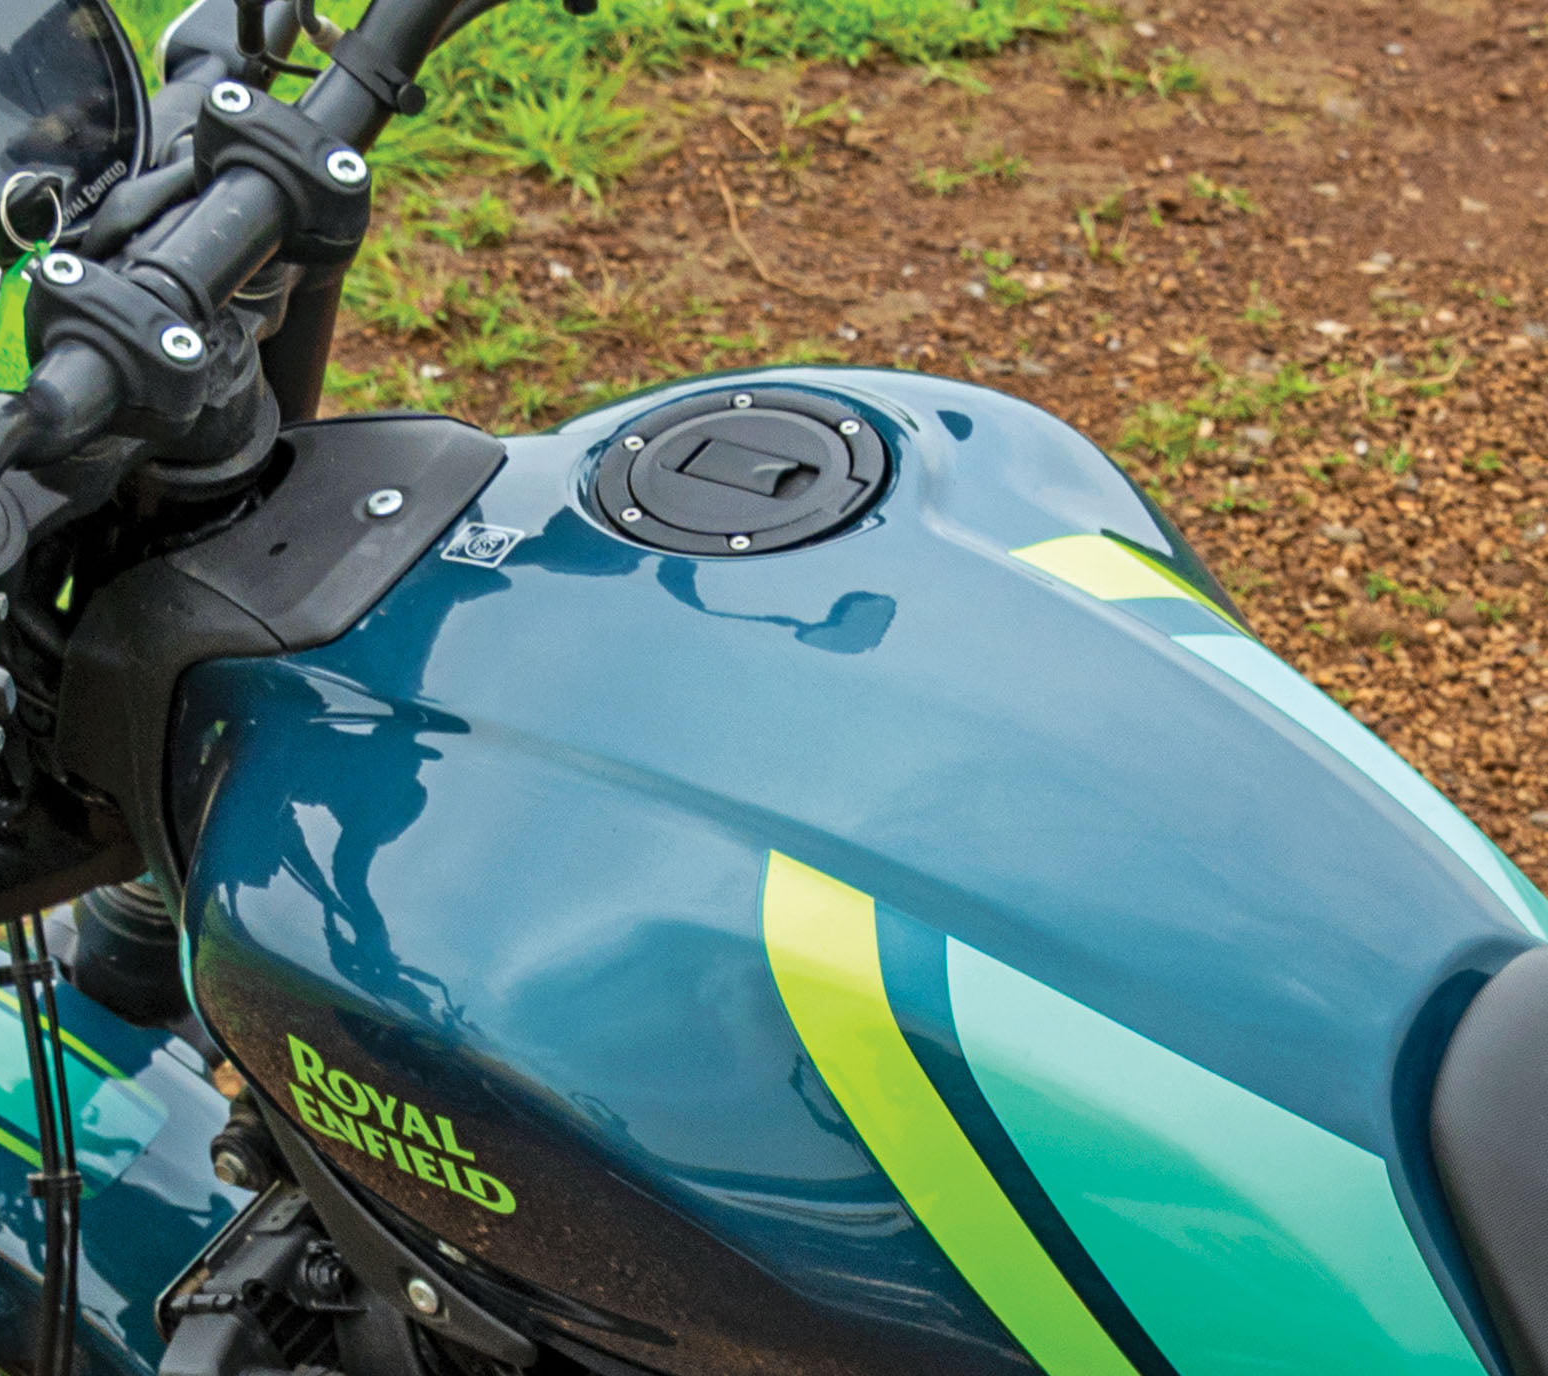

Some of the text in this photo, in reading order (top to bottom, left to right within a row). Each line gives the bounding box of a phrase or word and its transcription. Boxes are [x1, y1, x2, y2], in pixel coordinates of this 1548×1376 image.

[62, 196, 89, 225] OYAL
[286, 1032, 475, 1162] ROYAL
[288, 1082, 517, 1216] ENFIELD
